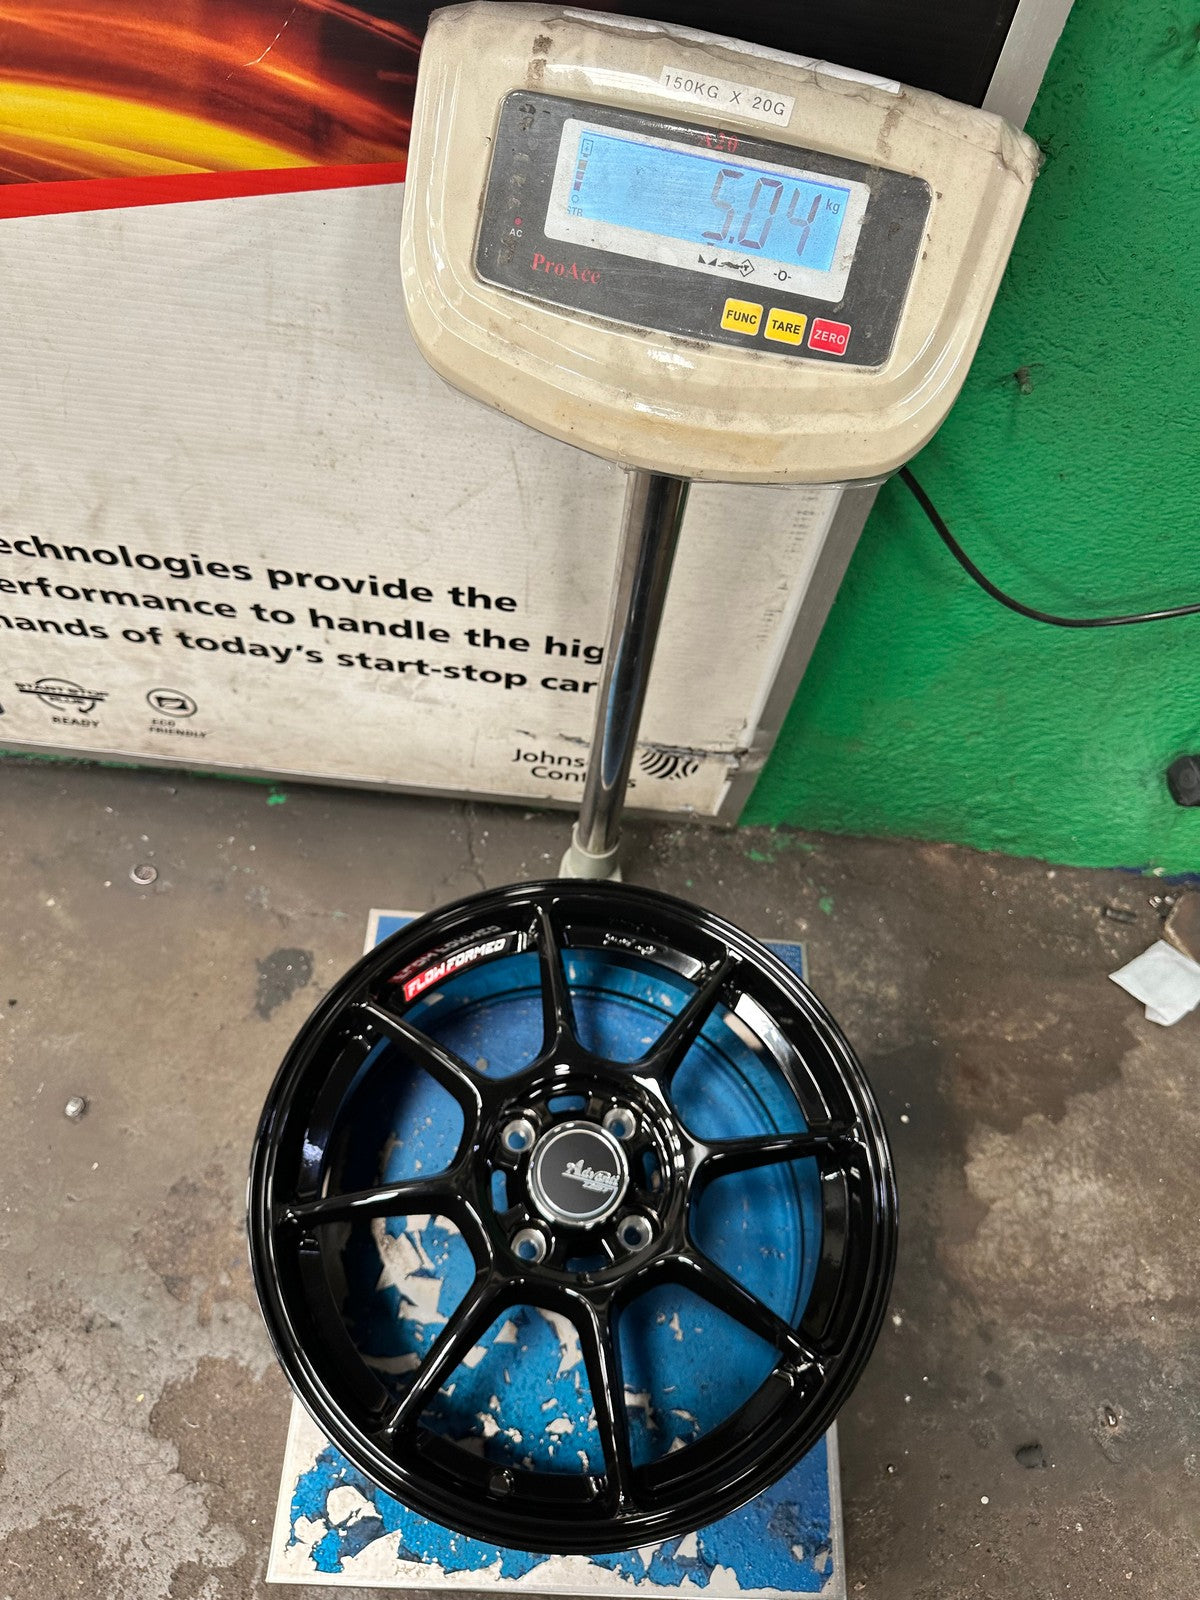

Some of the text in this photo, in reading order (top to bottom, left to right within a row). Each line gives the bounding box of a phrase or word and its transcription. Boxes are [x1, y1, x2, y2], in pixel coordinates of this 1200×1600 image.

[664, 74, 786, 116] 150KG X 20G
[701, 168, 841, 257] 5.04 kg
[509, 228, 523, 238] AC
[531, 252, 601, 284] ProAce
[726, 309, 757, 325] FUNC
[772, 319, 801, 335] TARE
[813, 329, 846, 345] ZERO
[0, 535, 518, 613] echnologies provide the
[0, 577, 604, 665] erformance to handle the hig
[0, 615, 598, 694] ands of today's start-stop car
[52, 715, 100, 728] READY
[512, 748, 585, 768] Johns
[406, 937, 507, 998] FLOW FORMED
